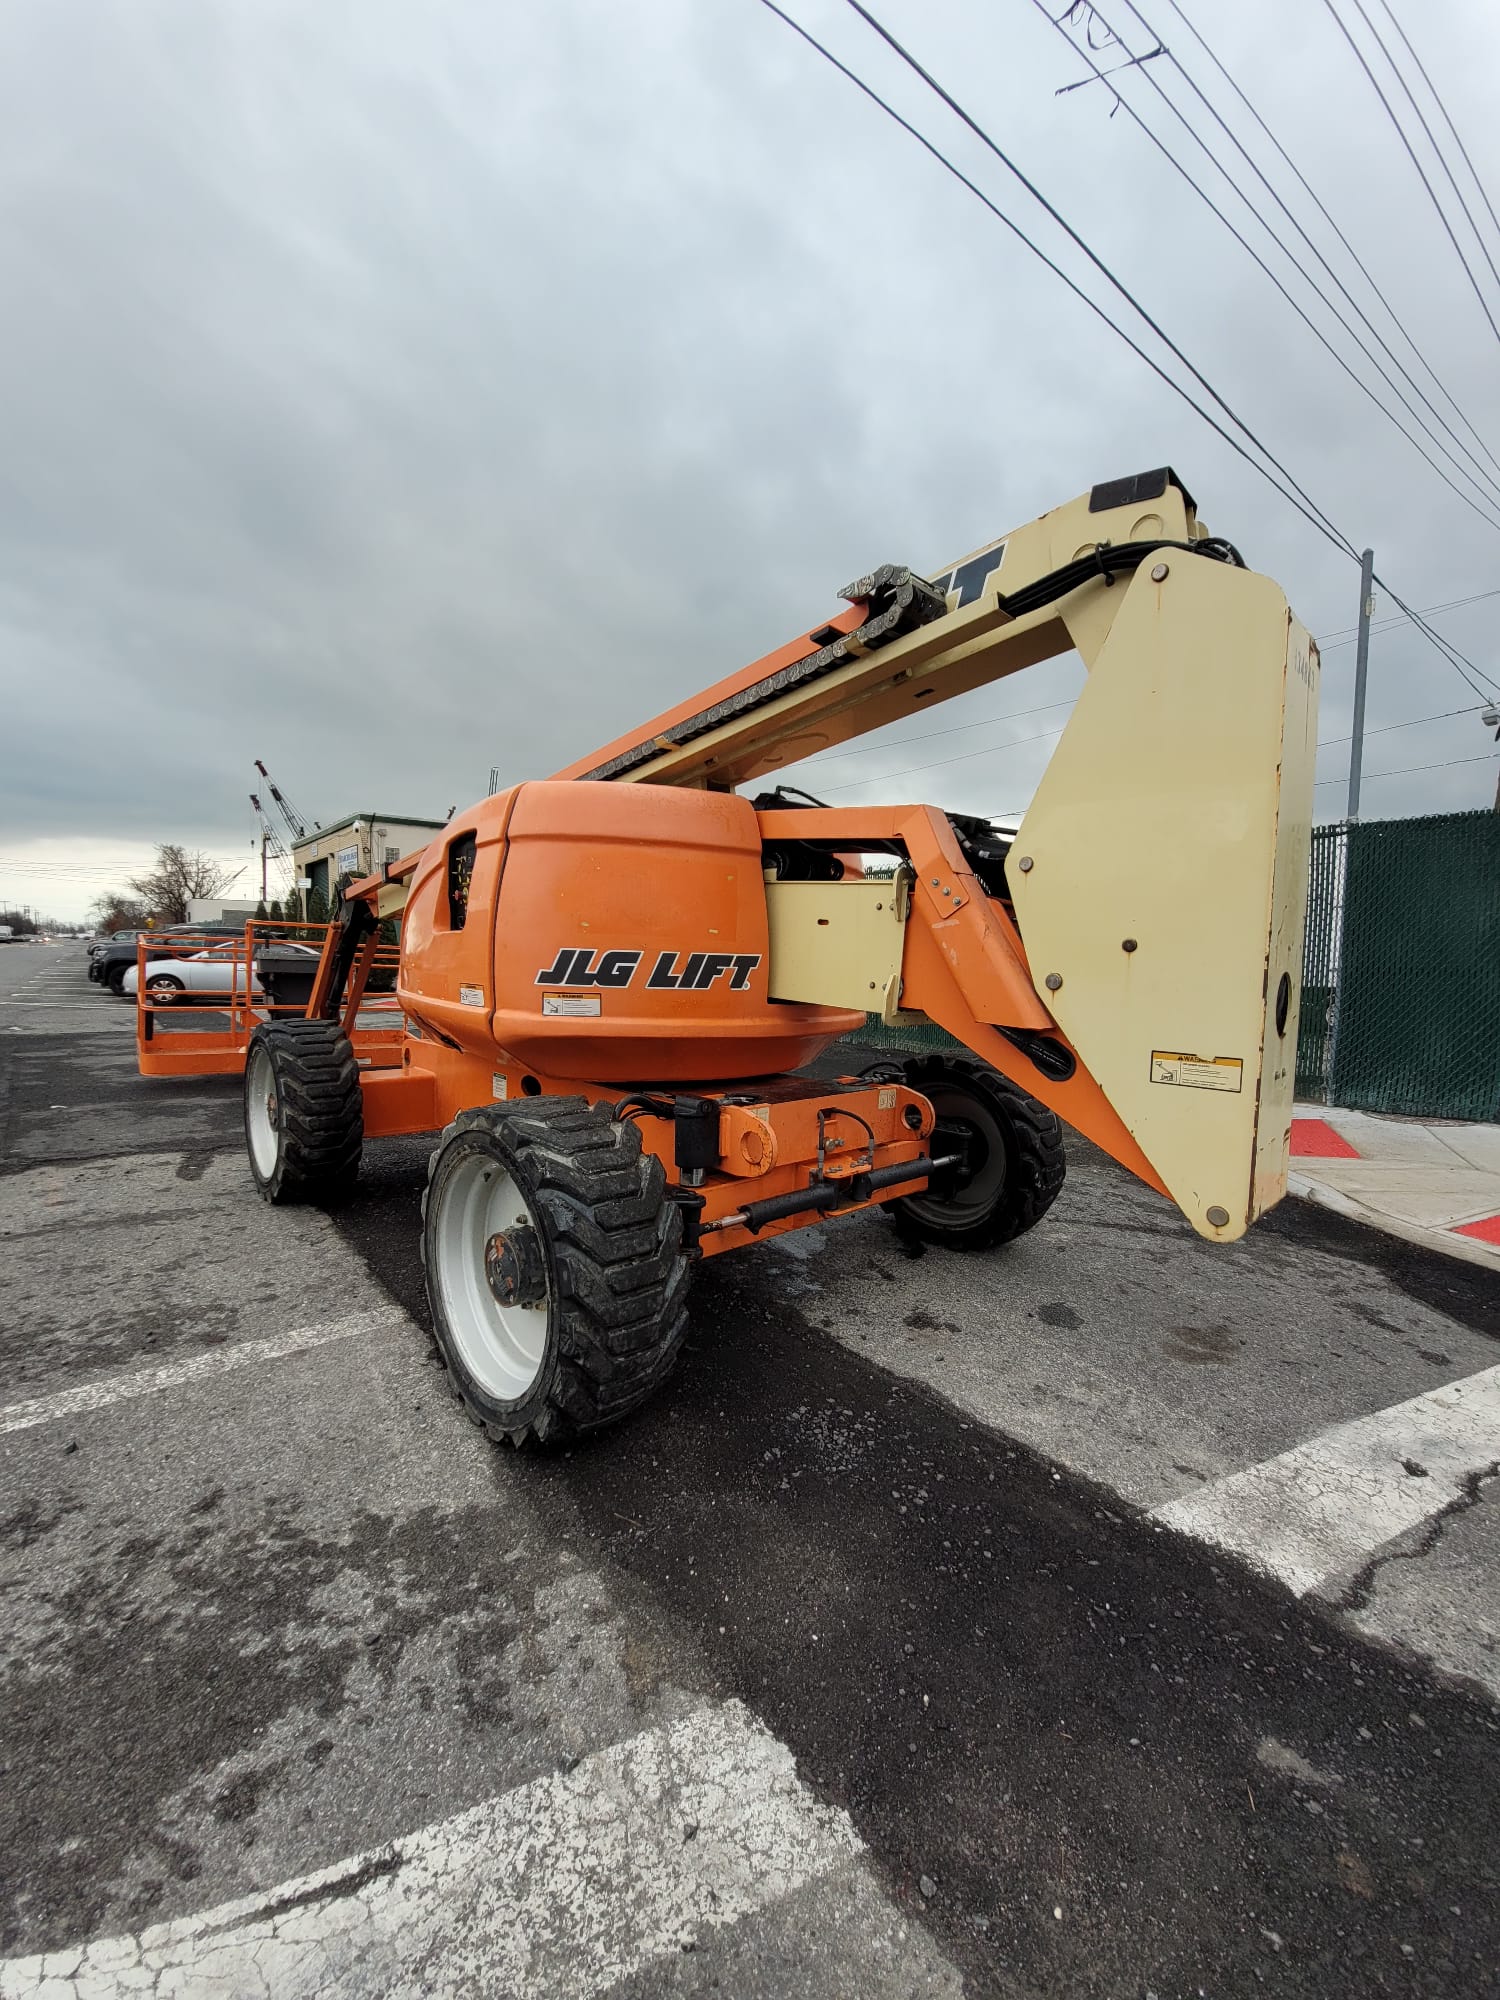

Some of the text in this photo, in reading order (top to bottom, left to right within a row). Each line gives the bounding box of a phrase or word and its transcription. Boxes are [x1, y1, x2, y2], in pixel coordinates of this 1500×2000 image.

[930, 541, 1008, 609] T
[534, 948, 762, 990] JLG LIFT
